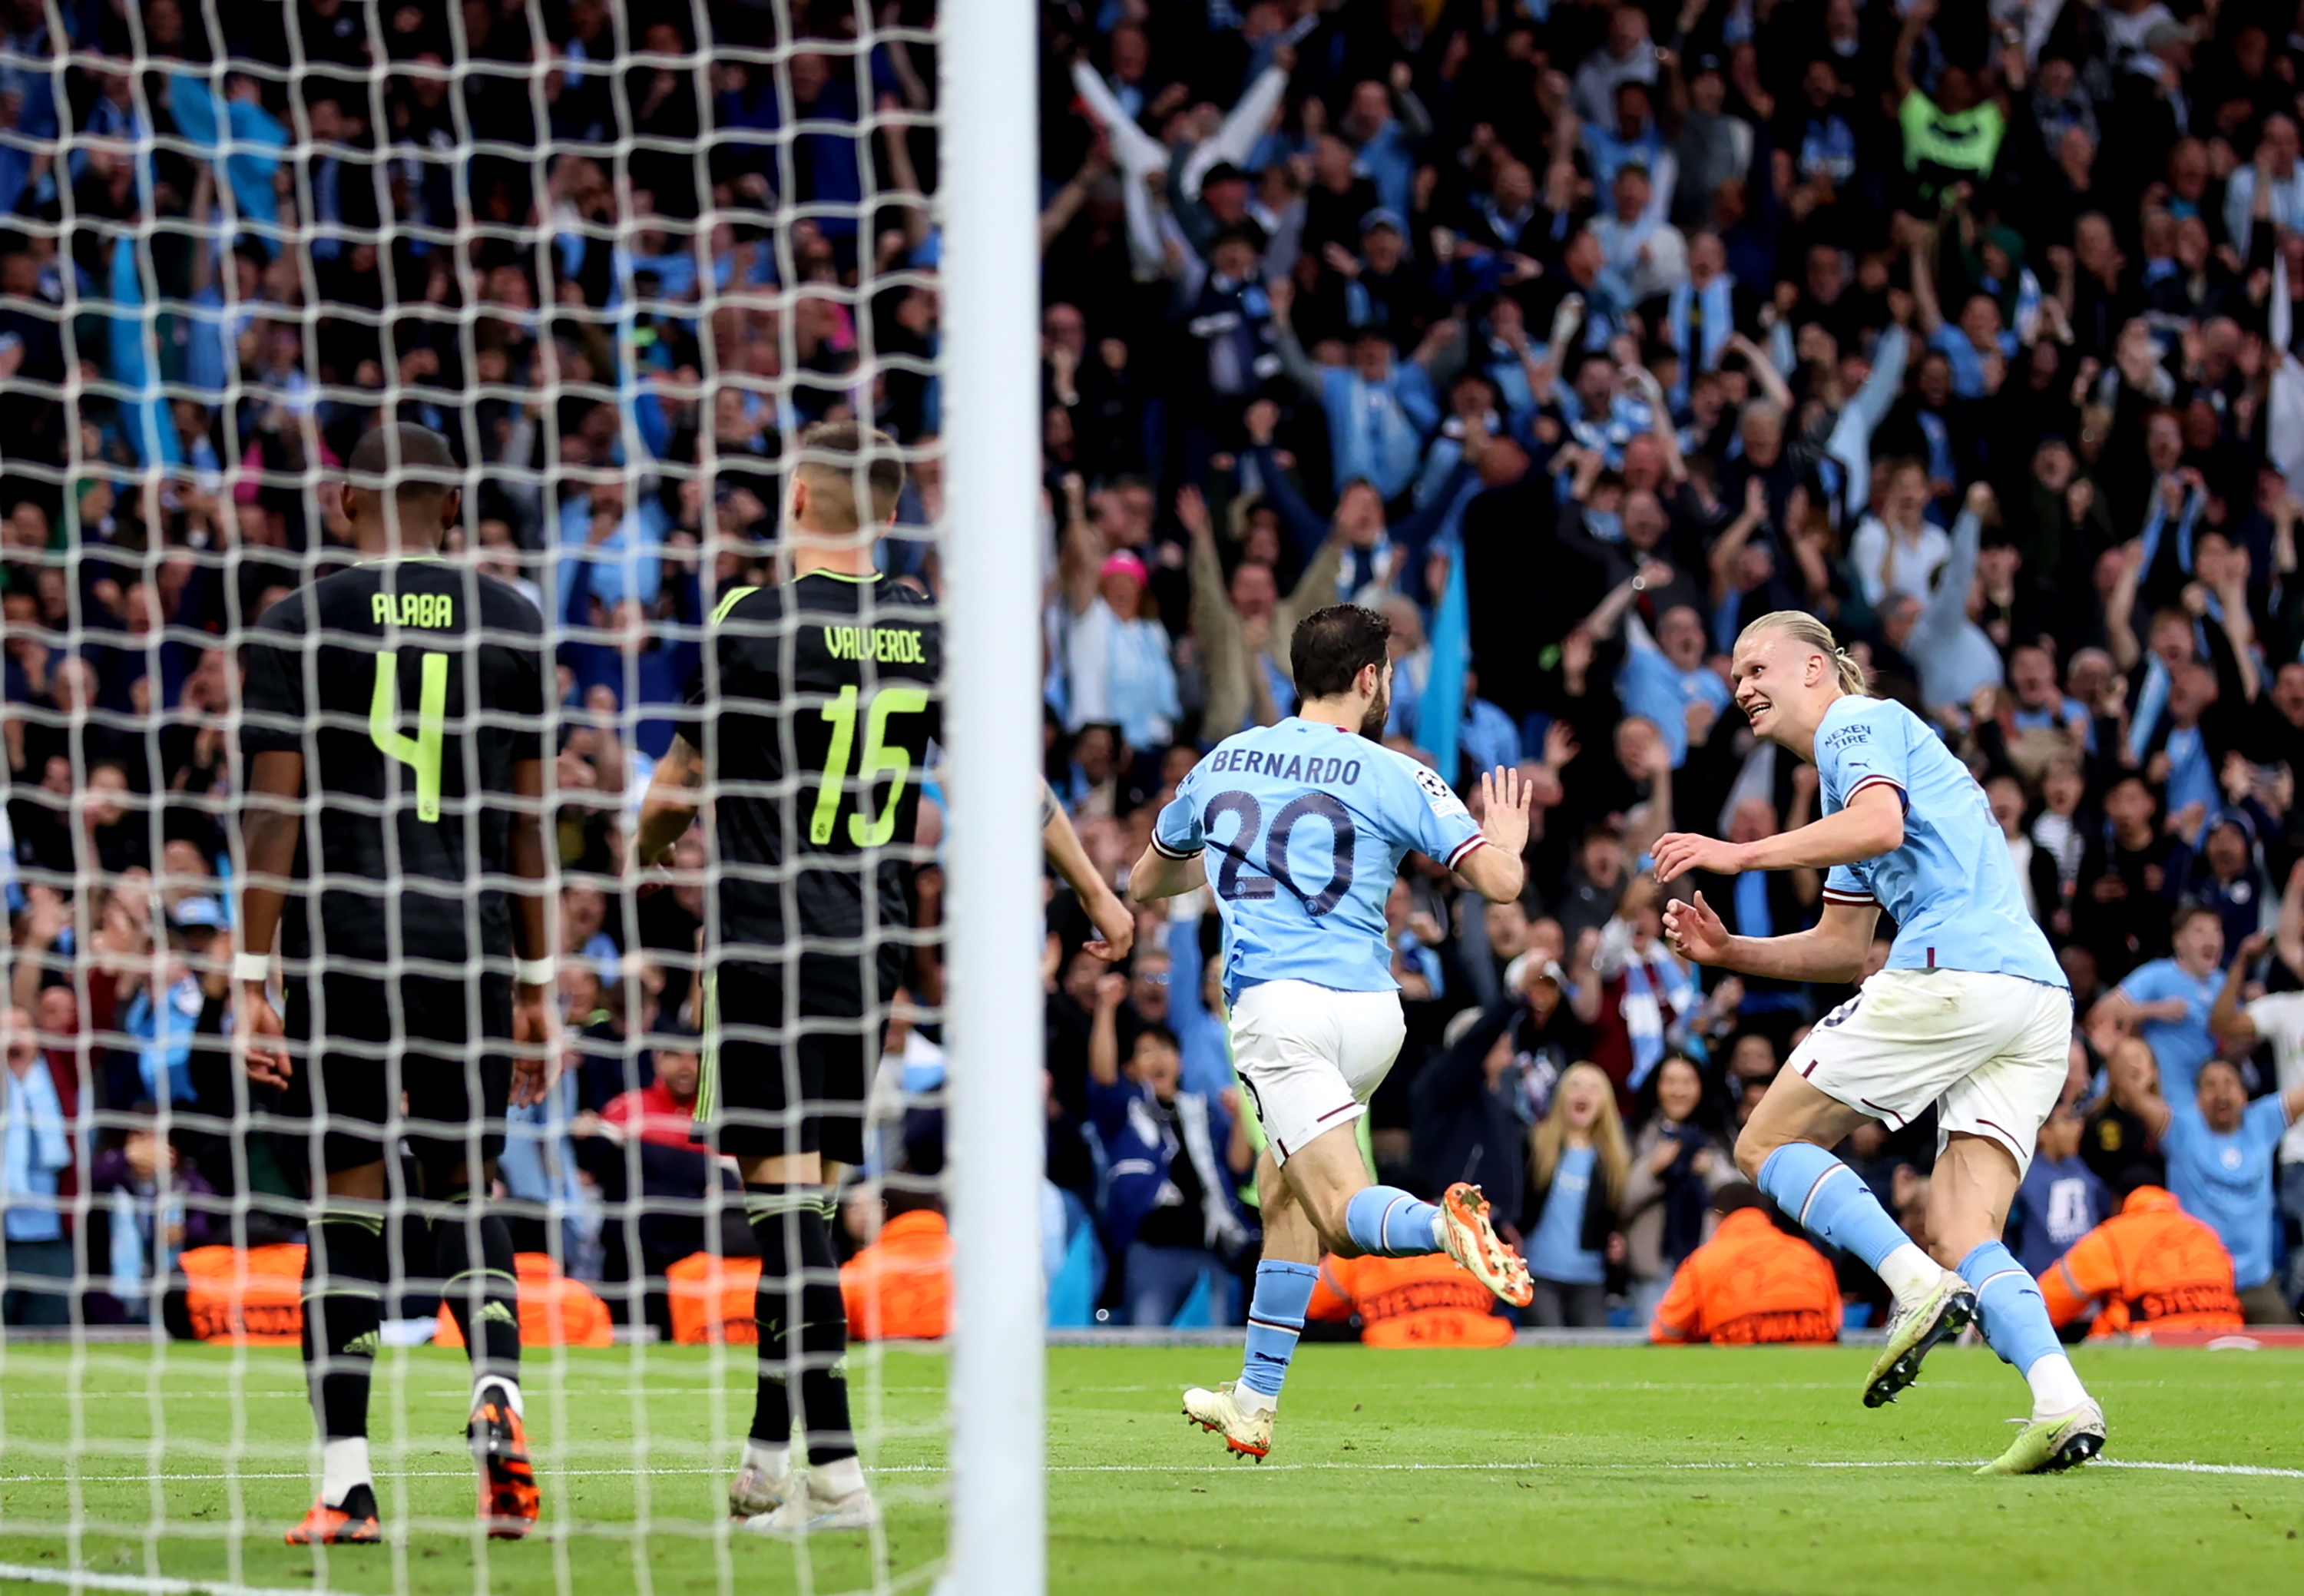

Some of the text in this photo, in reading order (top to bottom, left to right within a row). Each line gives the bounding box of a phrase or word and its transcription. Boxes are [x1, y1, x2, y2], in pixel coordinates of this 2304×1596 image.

[372, 593, 452, 627] ALABA
[824, 626, 926, 664] VALVERDE
[369, 651, 449, 823] 4
[1825, 724, 1872, 749] NEXEN
[1832, 734, 1869, 750] TIRE
[810, 685, 929, 847] 15
[1210, 749, 1362, 786] BERNARDO
[1203, 790, 1356, 917] 20
